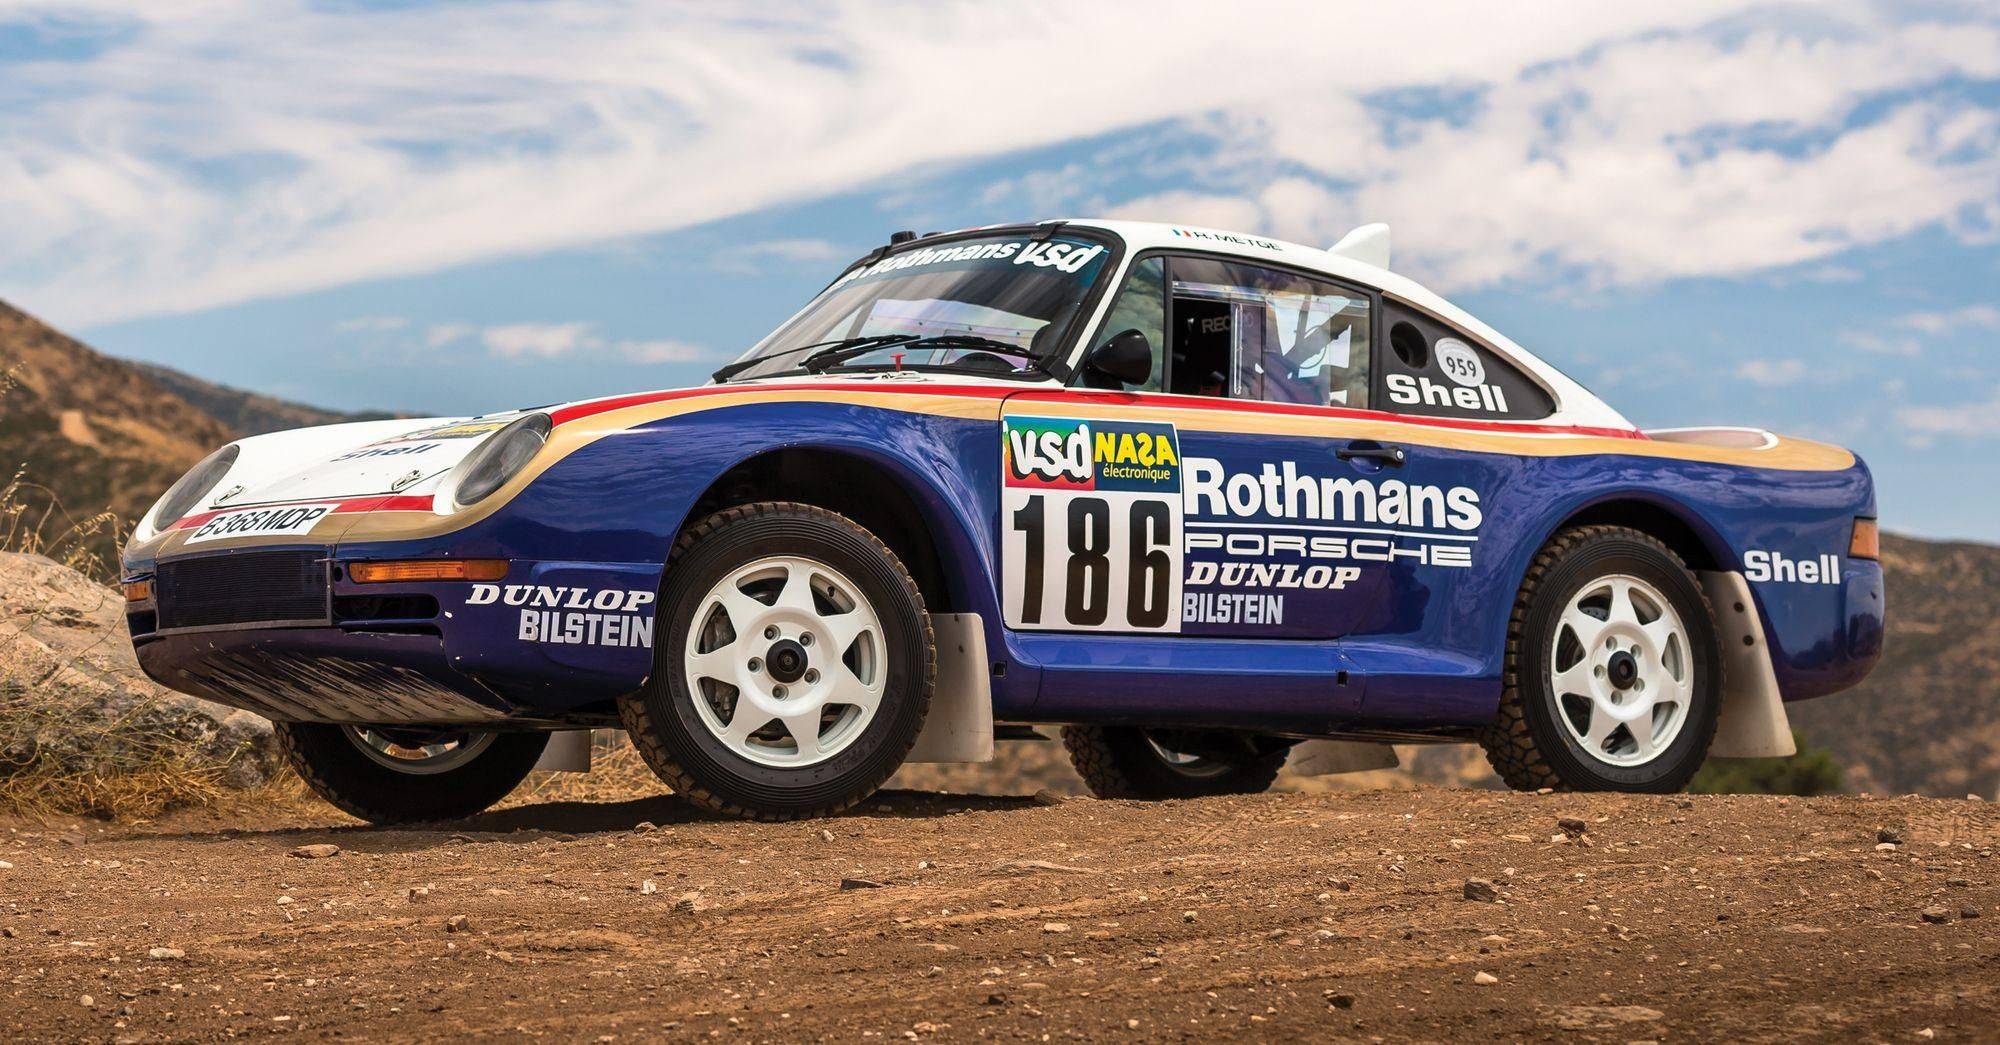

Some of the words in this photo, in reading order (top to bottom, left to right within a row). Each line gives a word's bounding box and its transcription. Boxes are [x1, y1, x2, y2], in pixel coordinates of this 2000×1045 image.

[859, 242, 1021, 279] Rothmans
[1446, 356, 1477, 377] 959
[1386, 373, 1508, 413] Shell
[330, 443, 442, 463] Shell
[1102, 463, 1171, 483] électronique
[1183, 457, 1483, 530] Rothmans
[1013, 494, 1172, 628] 186
[1185, 533, 1472, 567] PORSCHE
[1185, 562, 1361, 590] DUNLOP
[1744, 550, 1841, 585] Shell
[465, 583, 655, 612] DUNLOP
[1182, 592, 1284, 625] BILSTEIN
[518, 608, 654, 649] BILSTEIN
